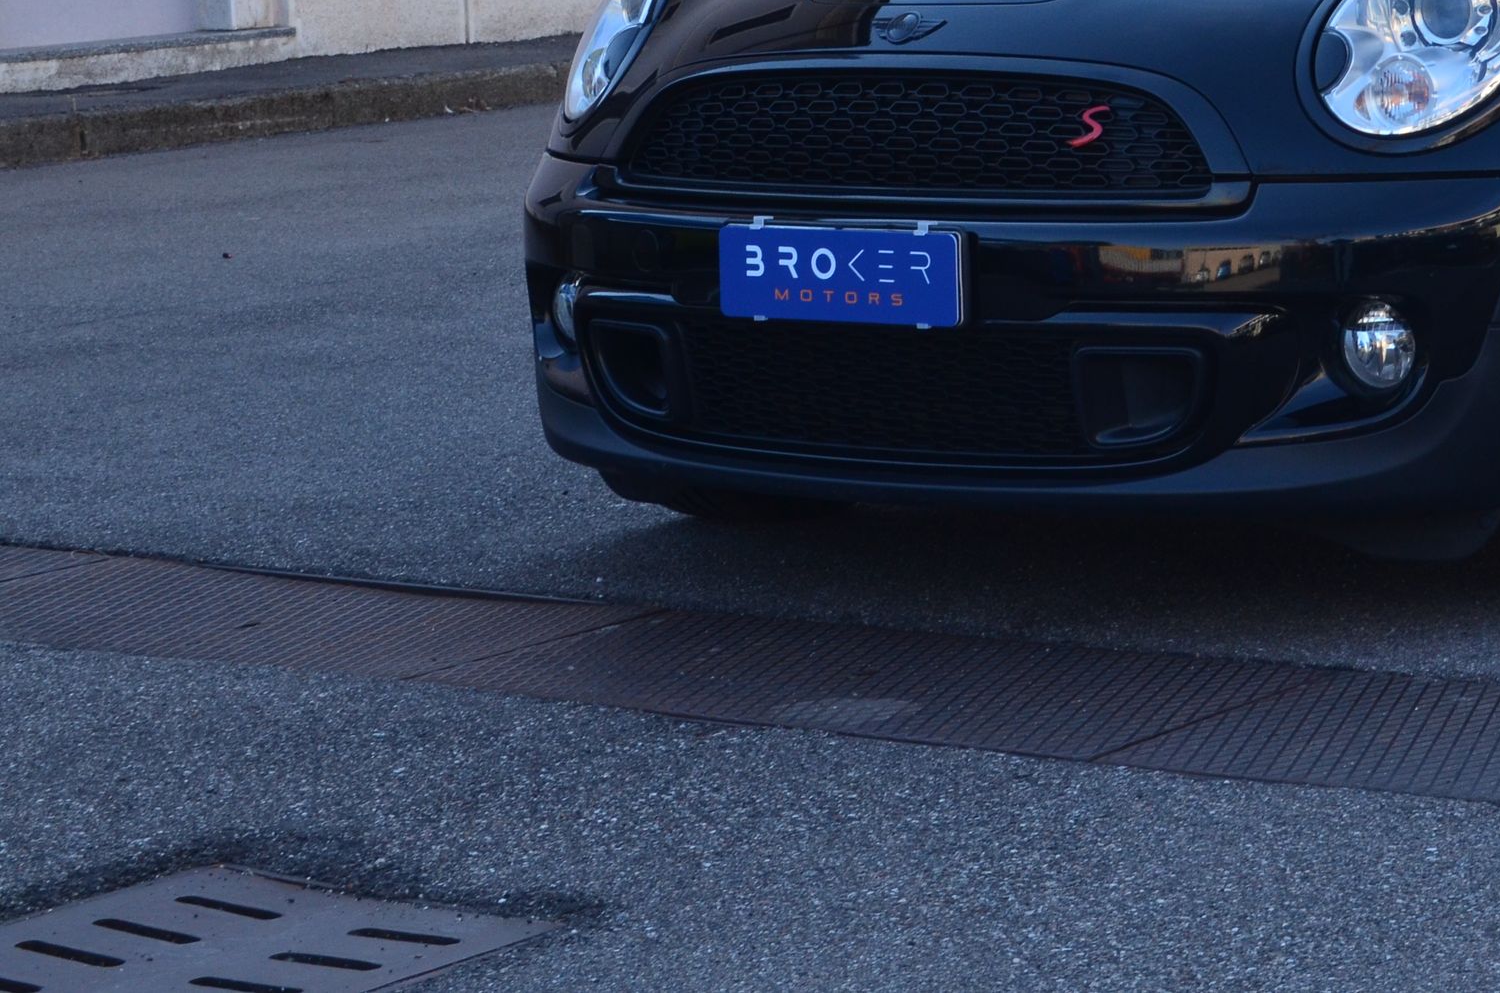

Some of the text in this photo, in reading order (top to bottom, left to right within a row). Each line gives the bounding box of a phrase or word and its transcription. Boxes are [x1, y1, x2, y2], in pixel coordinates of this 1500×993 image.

[1067, 105, 1110, 147] S
[745, 244, 931, 284] BROKER
[773, 289, 903, 306] MOTORS
